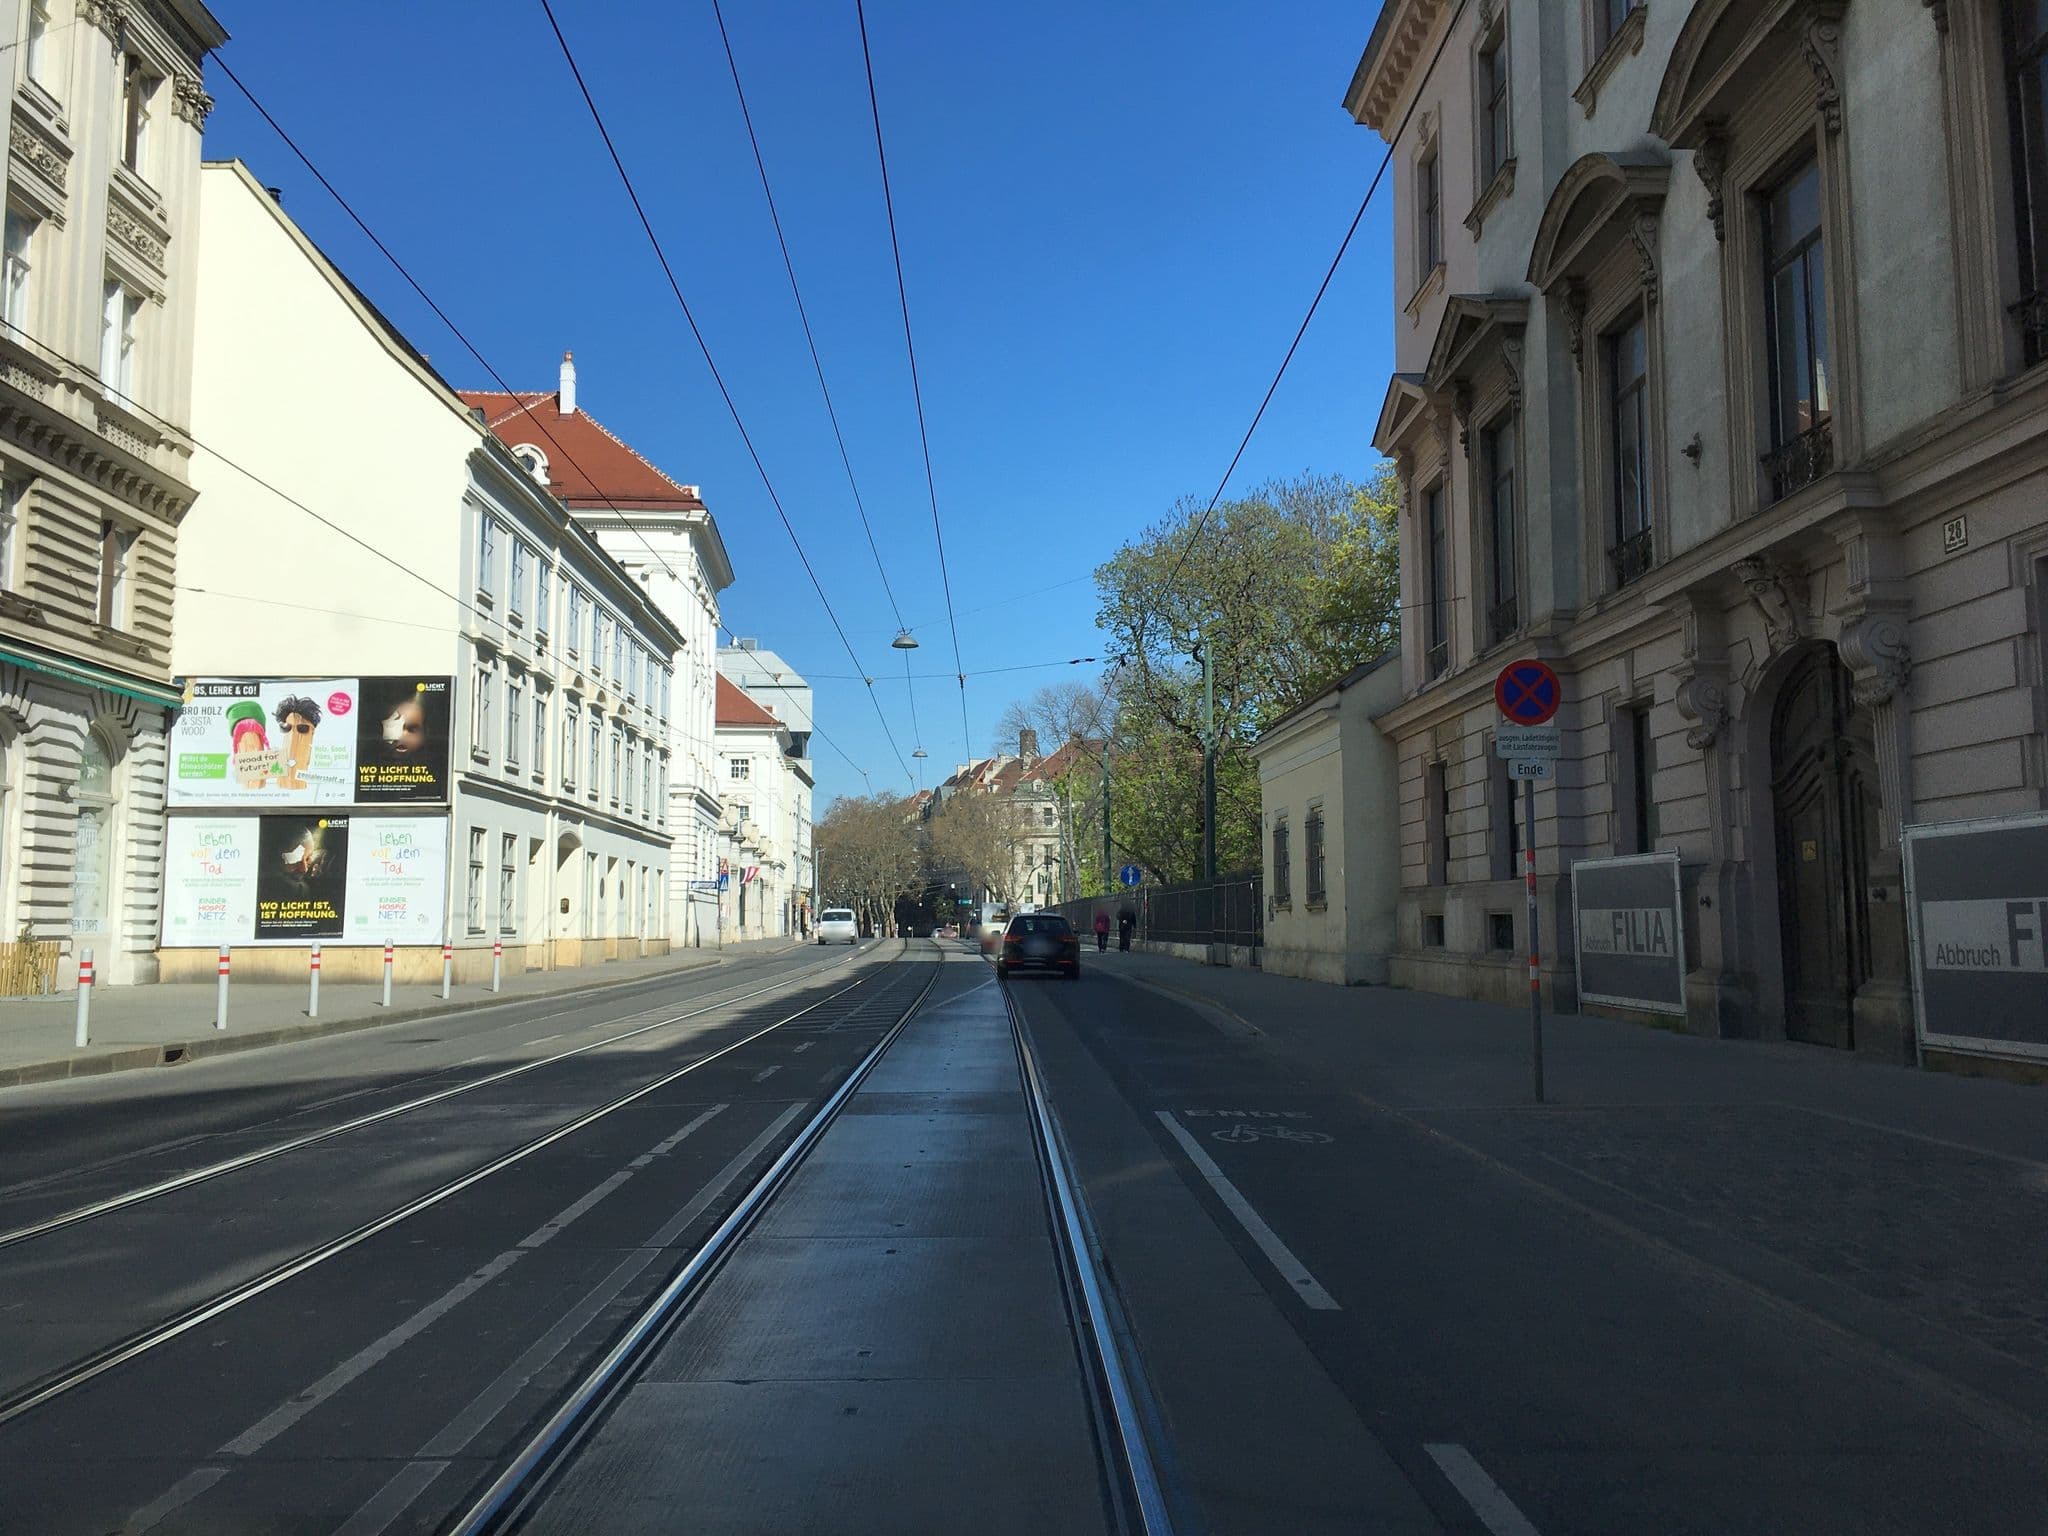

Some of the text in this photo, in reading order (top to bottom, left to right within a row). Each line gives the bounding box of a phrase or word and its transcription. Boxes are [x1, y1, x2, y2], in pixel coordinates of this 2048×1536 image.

[208, 686, 233, 695] LEHRE
[235, 686, 241, 695] &
[242, 685, 257, 695] CO!
[182, 706, 223, 716] BRO HOLZ
[181, 717, 212, 726] & SISTA
[181, 727, 206, 736] WOOD
[359, 766, 429, 775] WO LICHT IST,
[1518, 764, 1543, 775] Ende
[360, 775, 436, 783] IST HOFFNUNG.
[199, 832, 232, 846] Leben
[379, 832, 412, 846] Leben
[200, 862, 223, 875] Tod
[380, 861, 403, 875] Tod
[260, 902, 331, 910] WO LICHT IST,
[198, 911, 226, 921] NETZ
[261, 911, 338, 919] IST HOFFNUNG.
[378, 910, 407, 920] NETZ
[1612, 911, 1667, 953] FILIA
[1936, 942, 2000, 966] Abbruch
